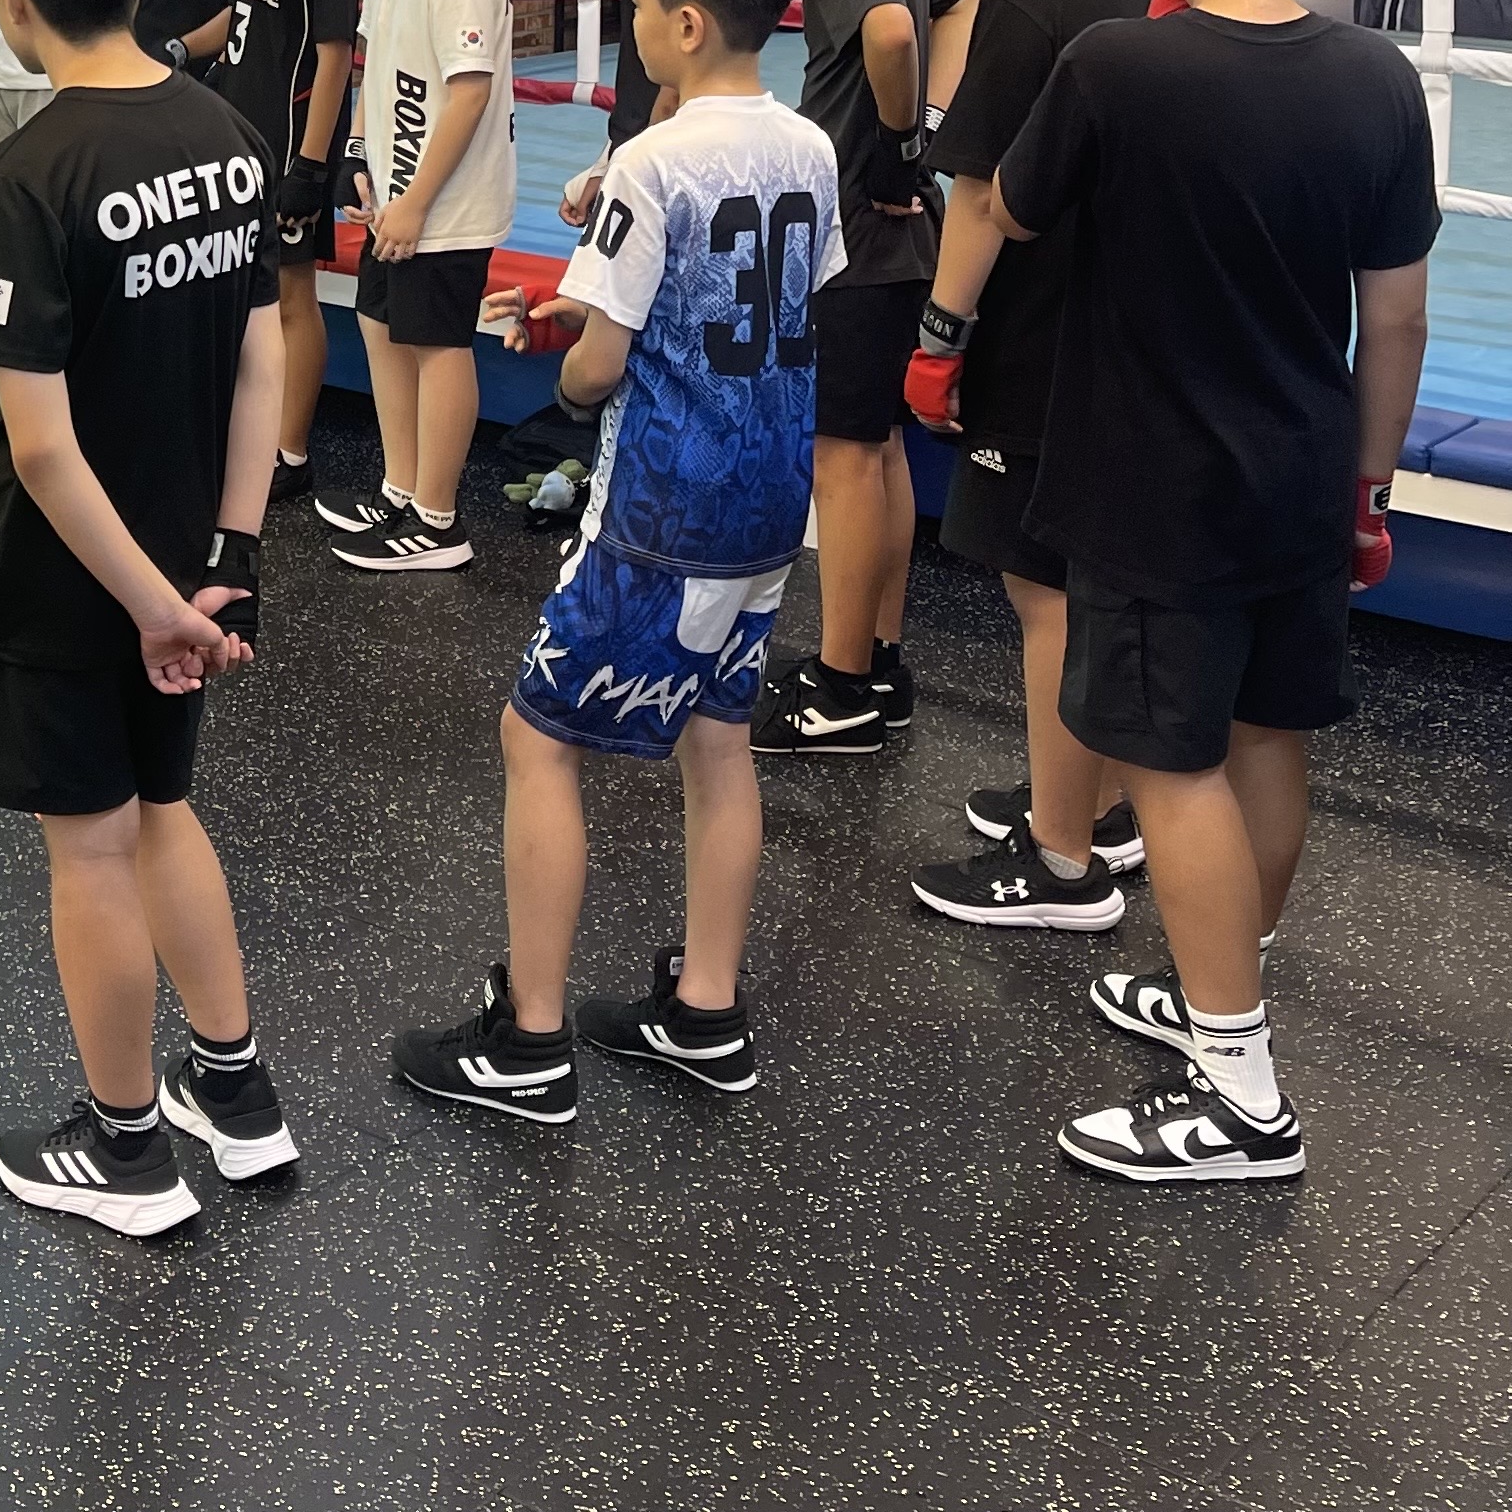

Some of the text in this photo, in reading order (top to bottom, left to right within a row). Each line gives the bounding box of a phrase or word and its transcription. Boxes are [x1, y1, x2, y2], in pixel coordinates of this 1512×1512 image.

[228, 0, 253, 65] 3
[124, 218, 261, 299] BOXING
[702, 191, 818, 377] 30
[970, 452, 1007, 474] adidas
